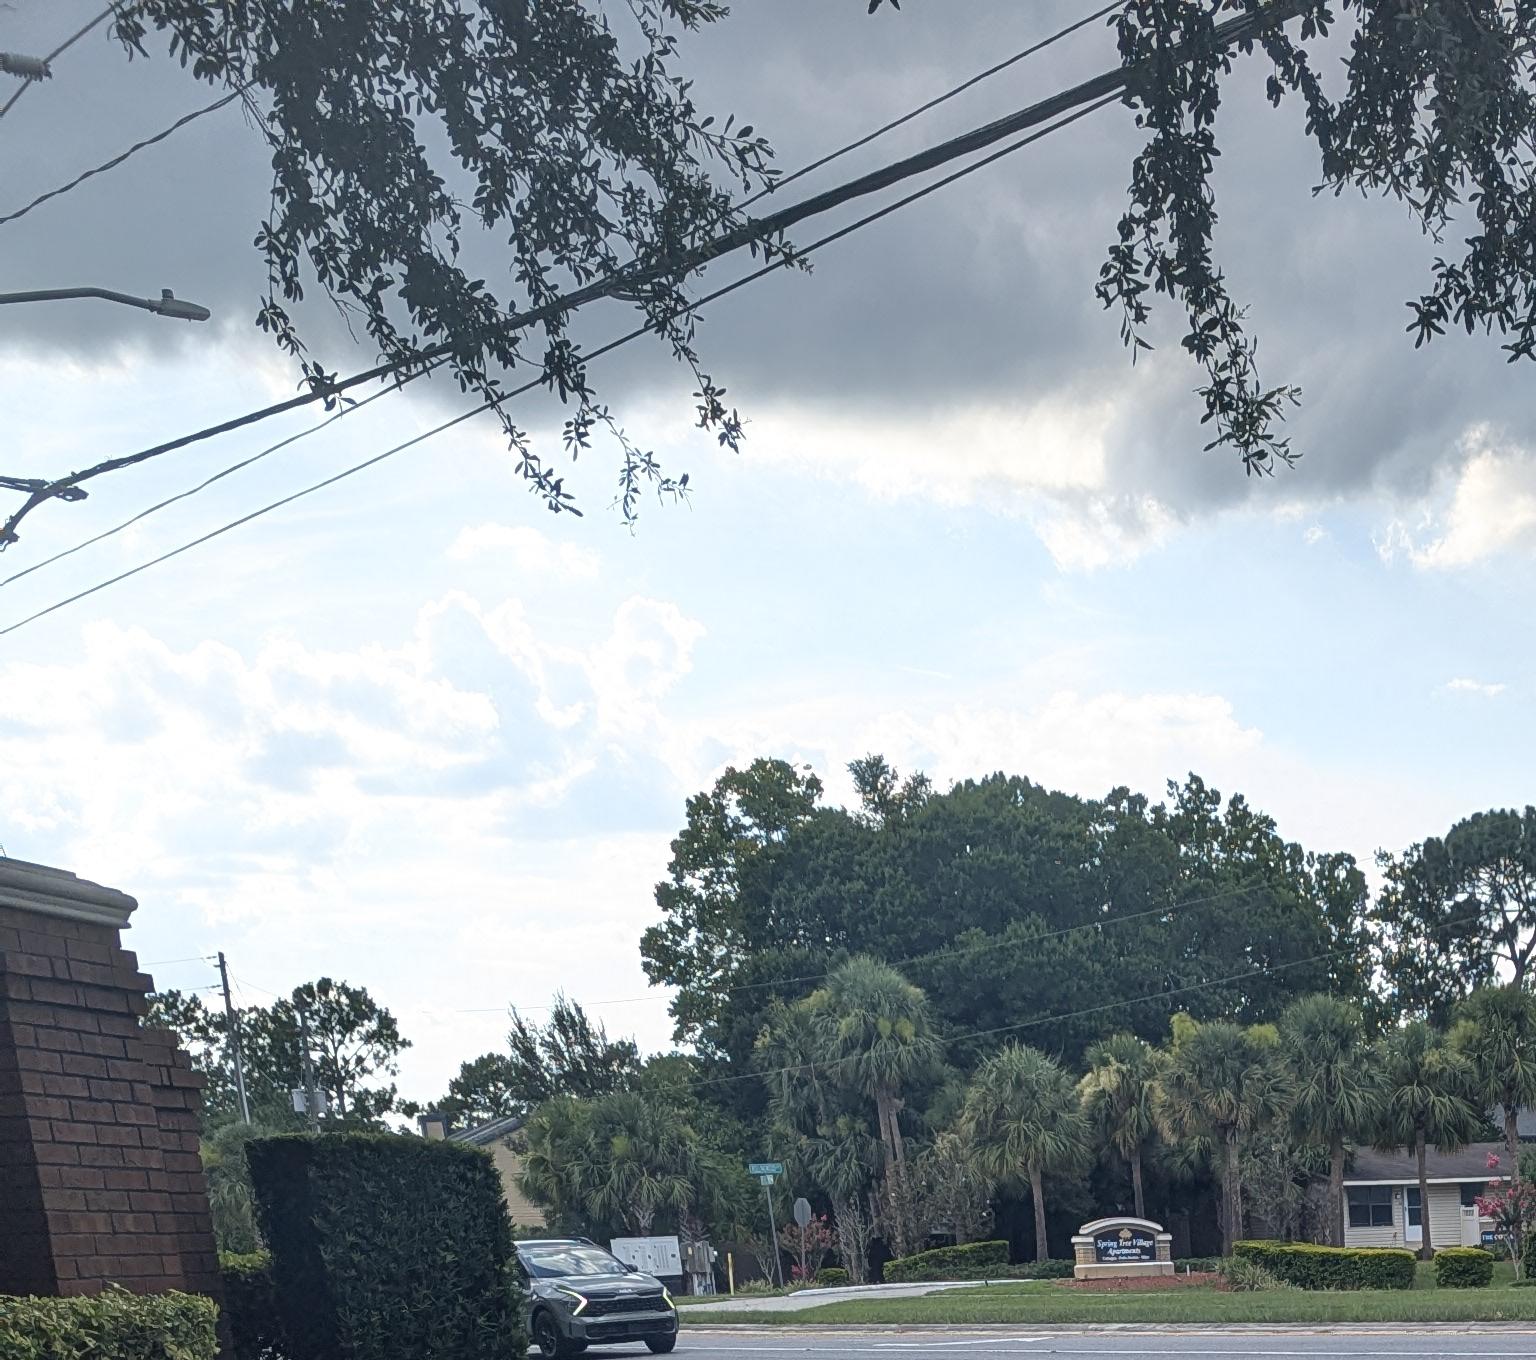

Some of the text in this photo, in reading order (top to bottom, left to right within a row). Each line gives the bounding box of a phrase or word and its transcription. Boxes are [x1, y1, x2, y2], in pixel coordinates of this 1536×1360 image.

[1097, 1238, 1153, 1249] Spring Tree Village
[1107, 1248, 1141, 1256] Apartments
